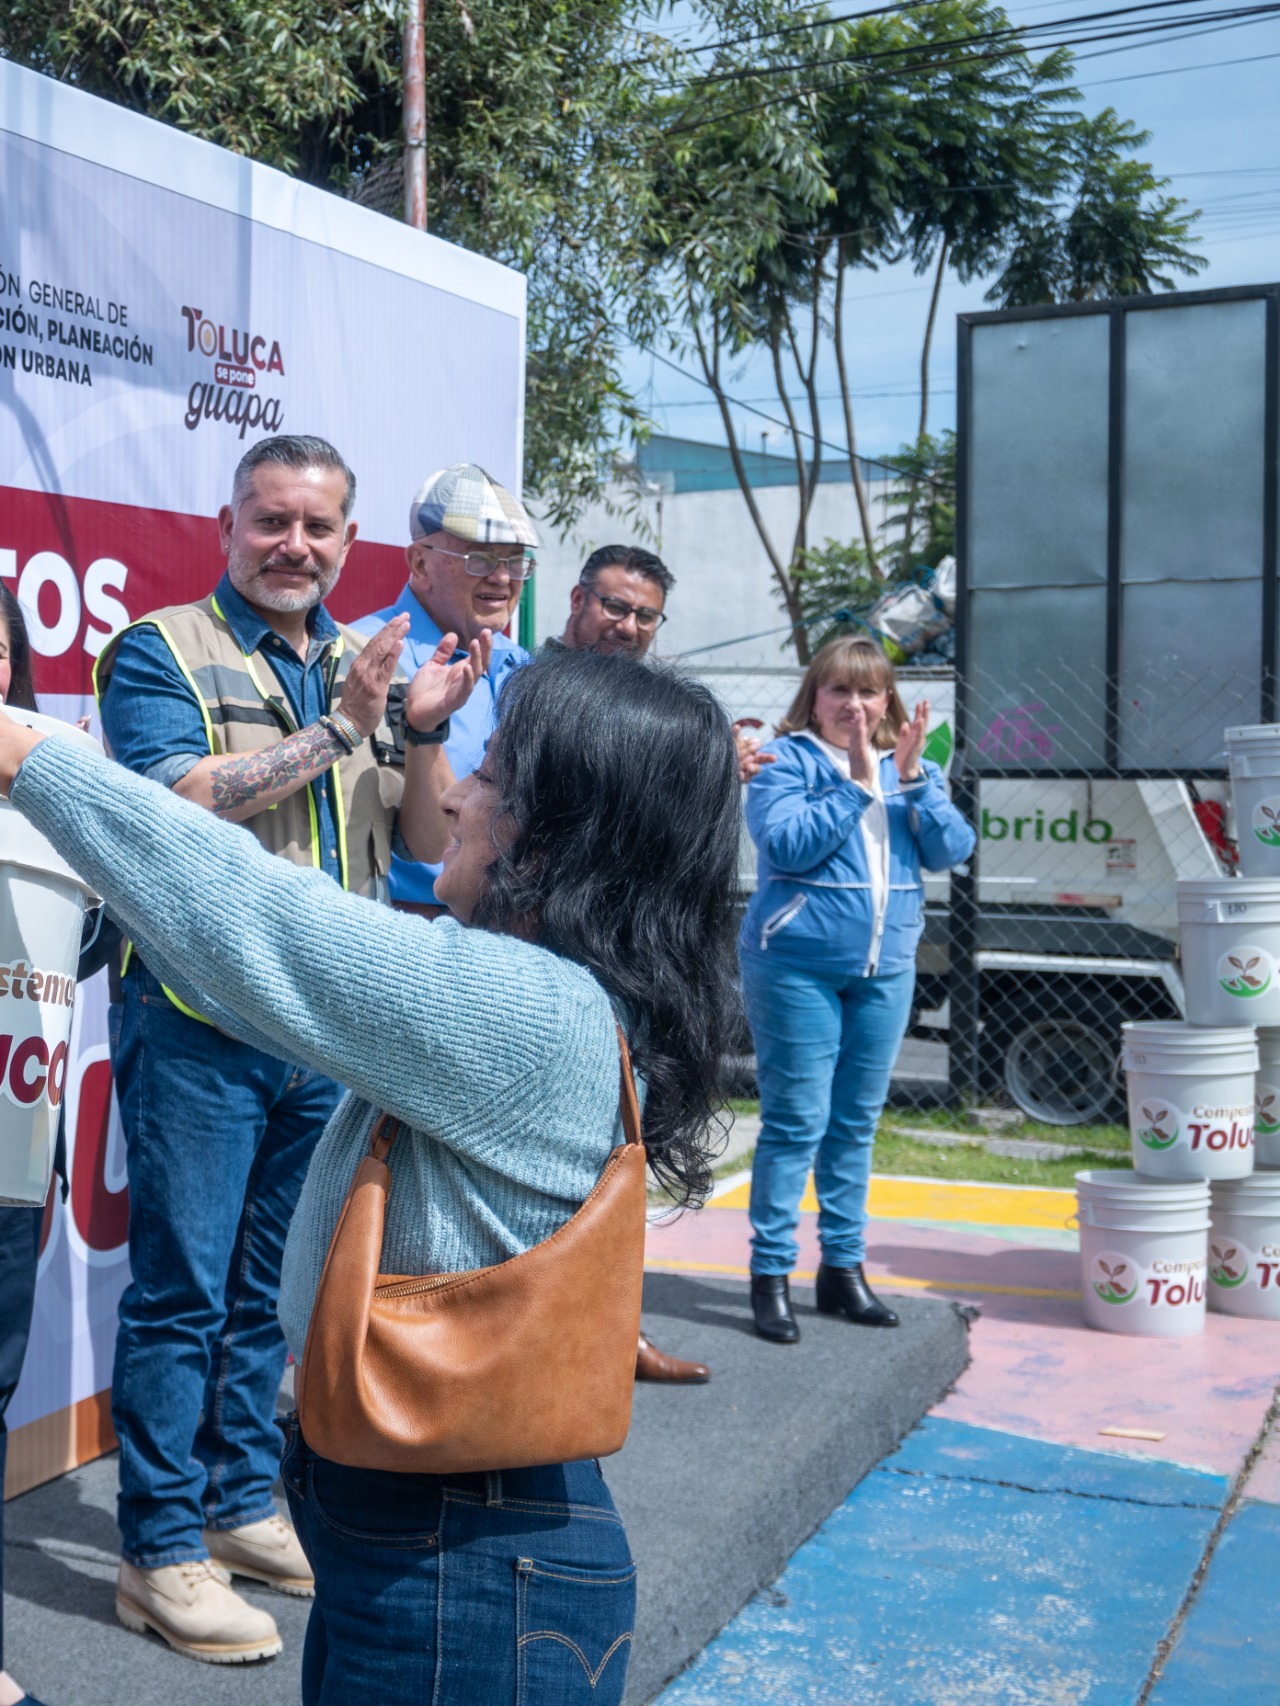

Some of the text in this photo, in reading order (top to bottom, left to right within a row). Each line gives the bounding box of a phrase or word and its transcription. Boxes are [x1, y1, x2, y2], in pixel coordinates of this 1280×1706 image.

[28, 280, 104, 322] GENERAL
[108, 301, 128, 327] DE
[47, 318, 154, 366] PLANEACIÓN
[181, 305, 285, 376] TOLUCA
[21, 348, 93, 387] URBANA
[216, 366, 254, 386] se pone
[184, 381, 285, 440] guapa
